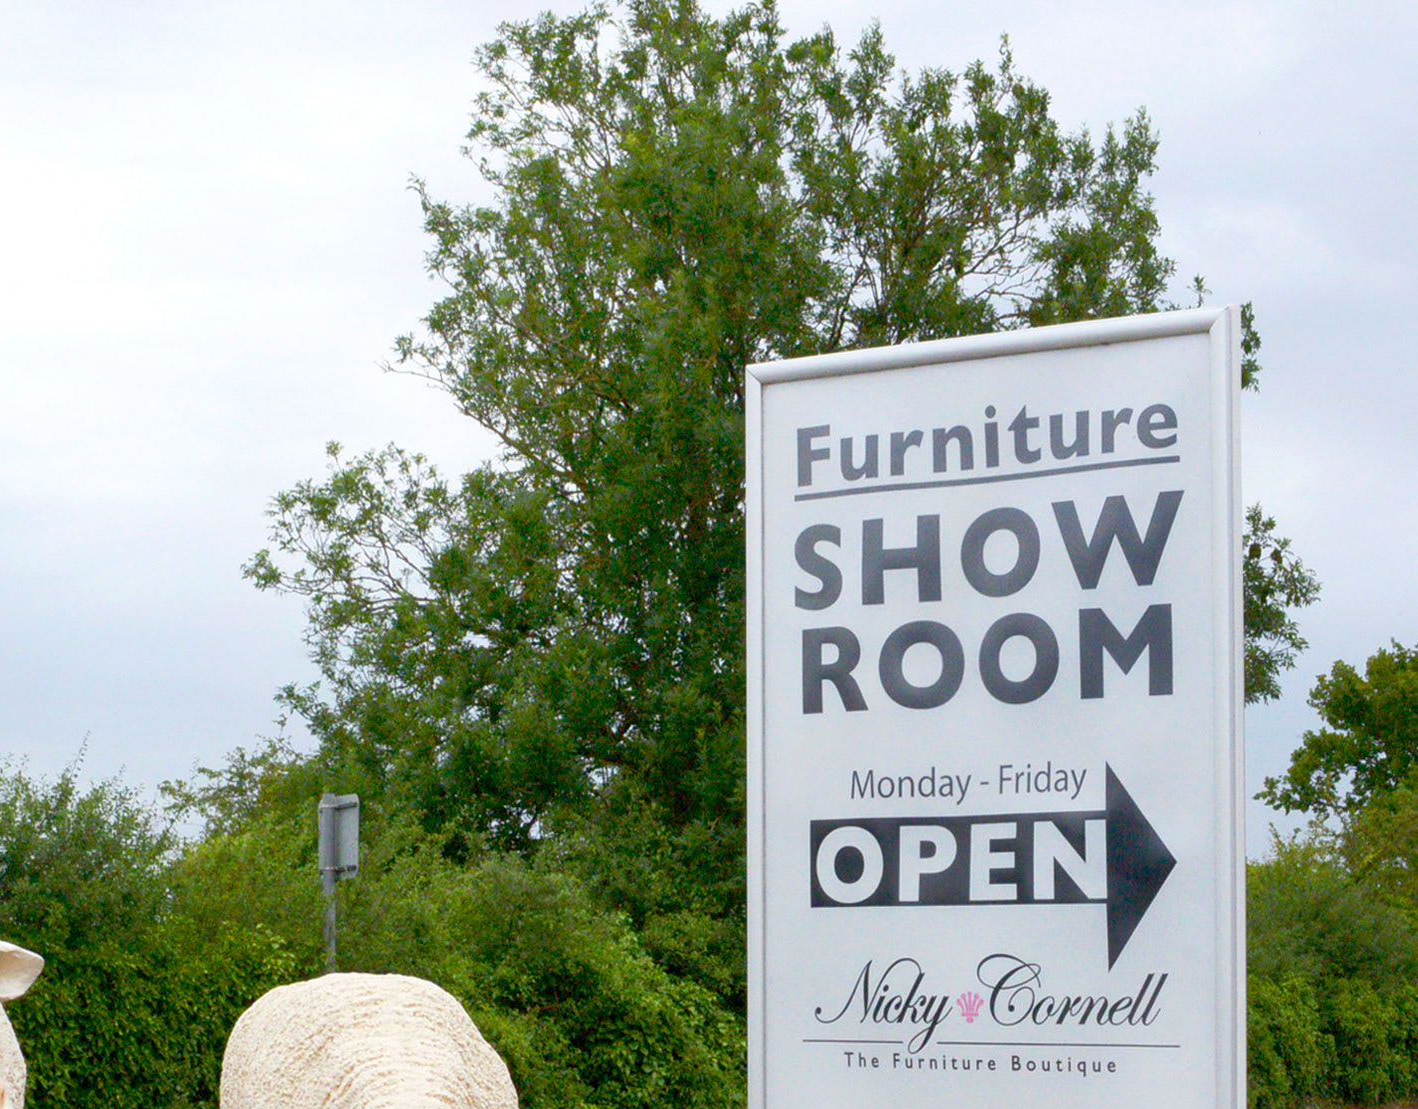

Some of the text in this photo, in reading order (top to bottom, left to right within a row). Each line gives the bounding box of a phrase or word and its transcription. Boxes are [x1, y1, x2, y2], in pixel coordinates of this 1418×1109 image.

[796, 403, 1178, 487] Furniture
[794, 490, 1185, 611] SHOW
[802, 603, 1174, 714] ROOM
[850, 767, 972, 805] Monday
[998, 761, 1088, 800] Friday
[816, 819, 1108, 904] OPEN
[814, 953, 1169, 1054] Nicky Cornell
[844, 1052, 1117, 1077] The Furniture Boutique
